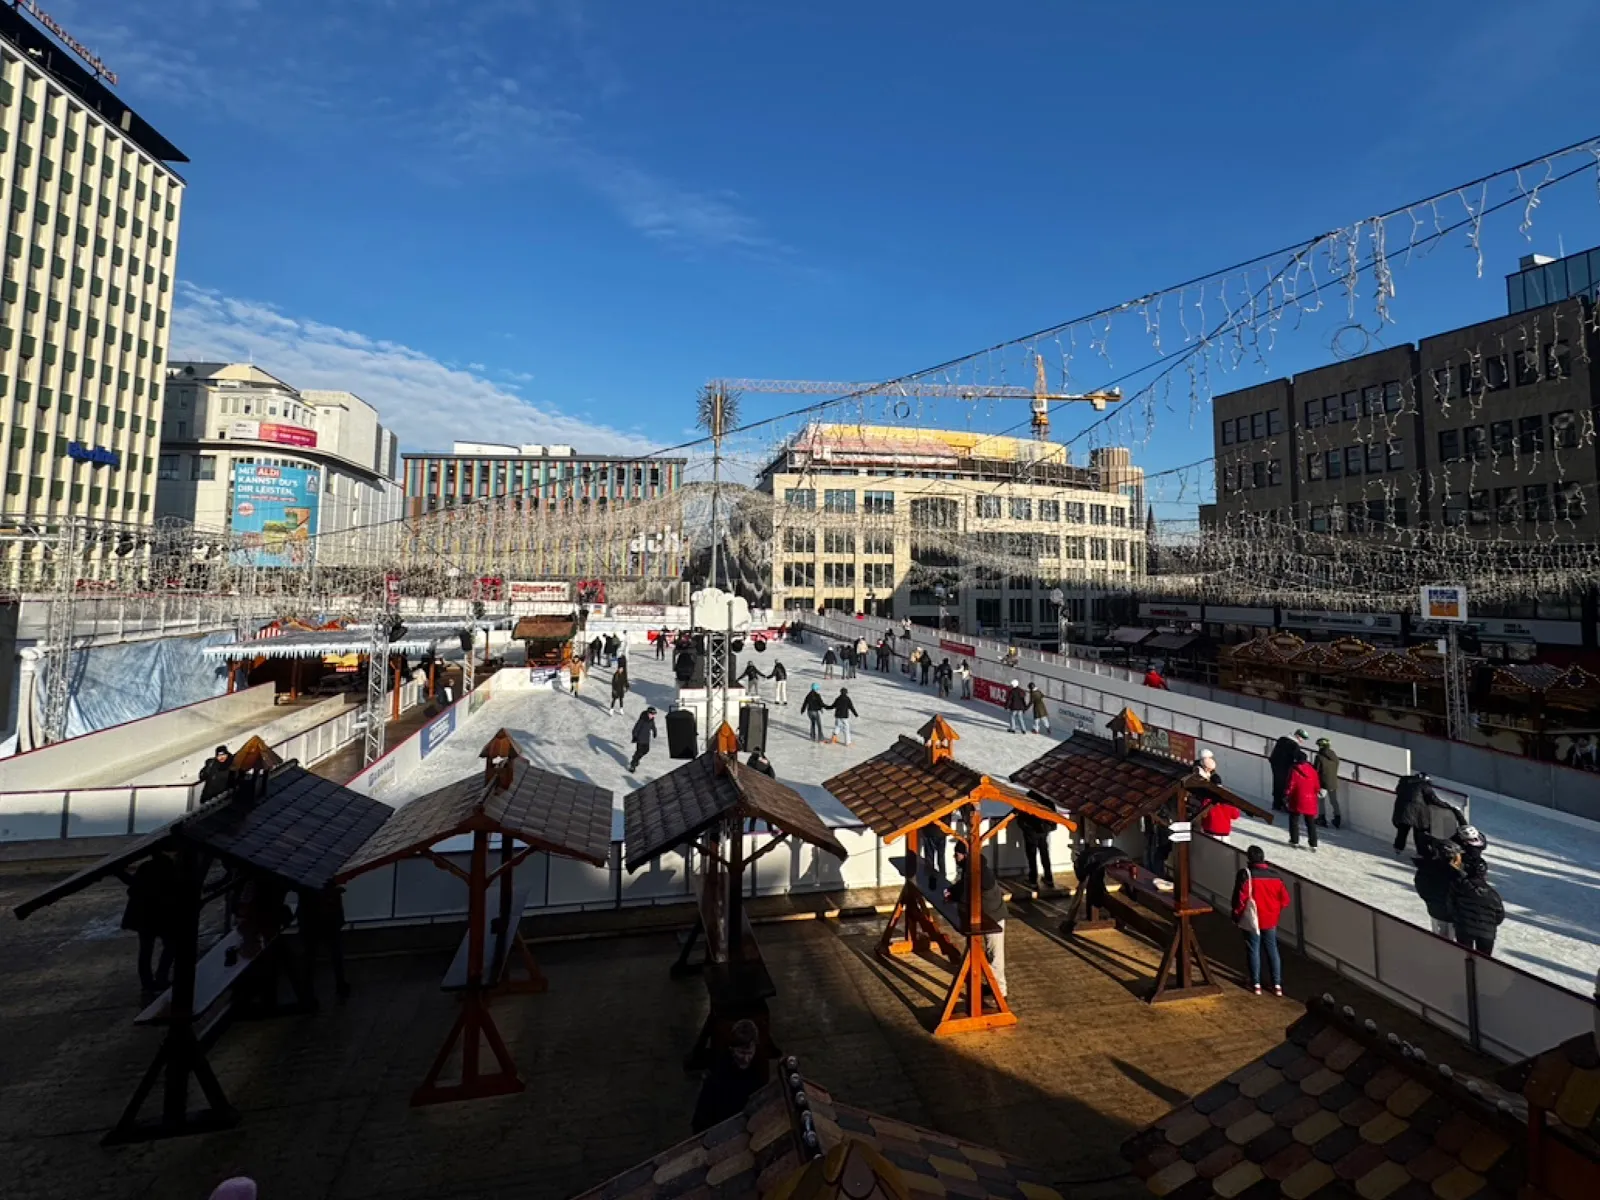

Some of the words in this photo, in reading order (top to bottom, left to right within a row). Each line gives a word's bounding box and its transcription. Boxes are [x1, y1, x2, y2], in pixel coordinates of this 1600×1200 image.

[238, 466, 254, 475] MIT
[258, 467, 280, 477] ALDI
[238, 476, 277, 485] KANNST
[279, 478, 298, 487] DU'S
[238, 485, 253, 493] DIR
